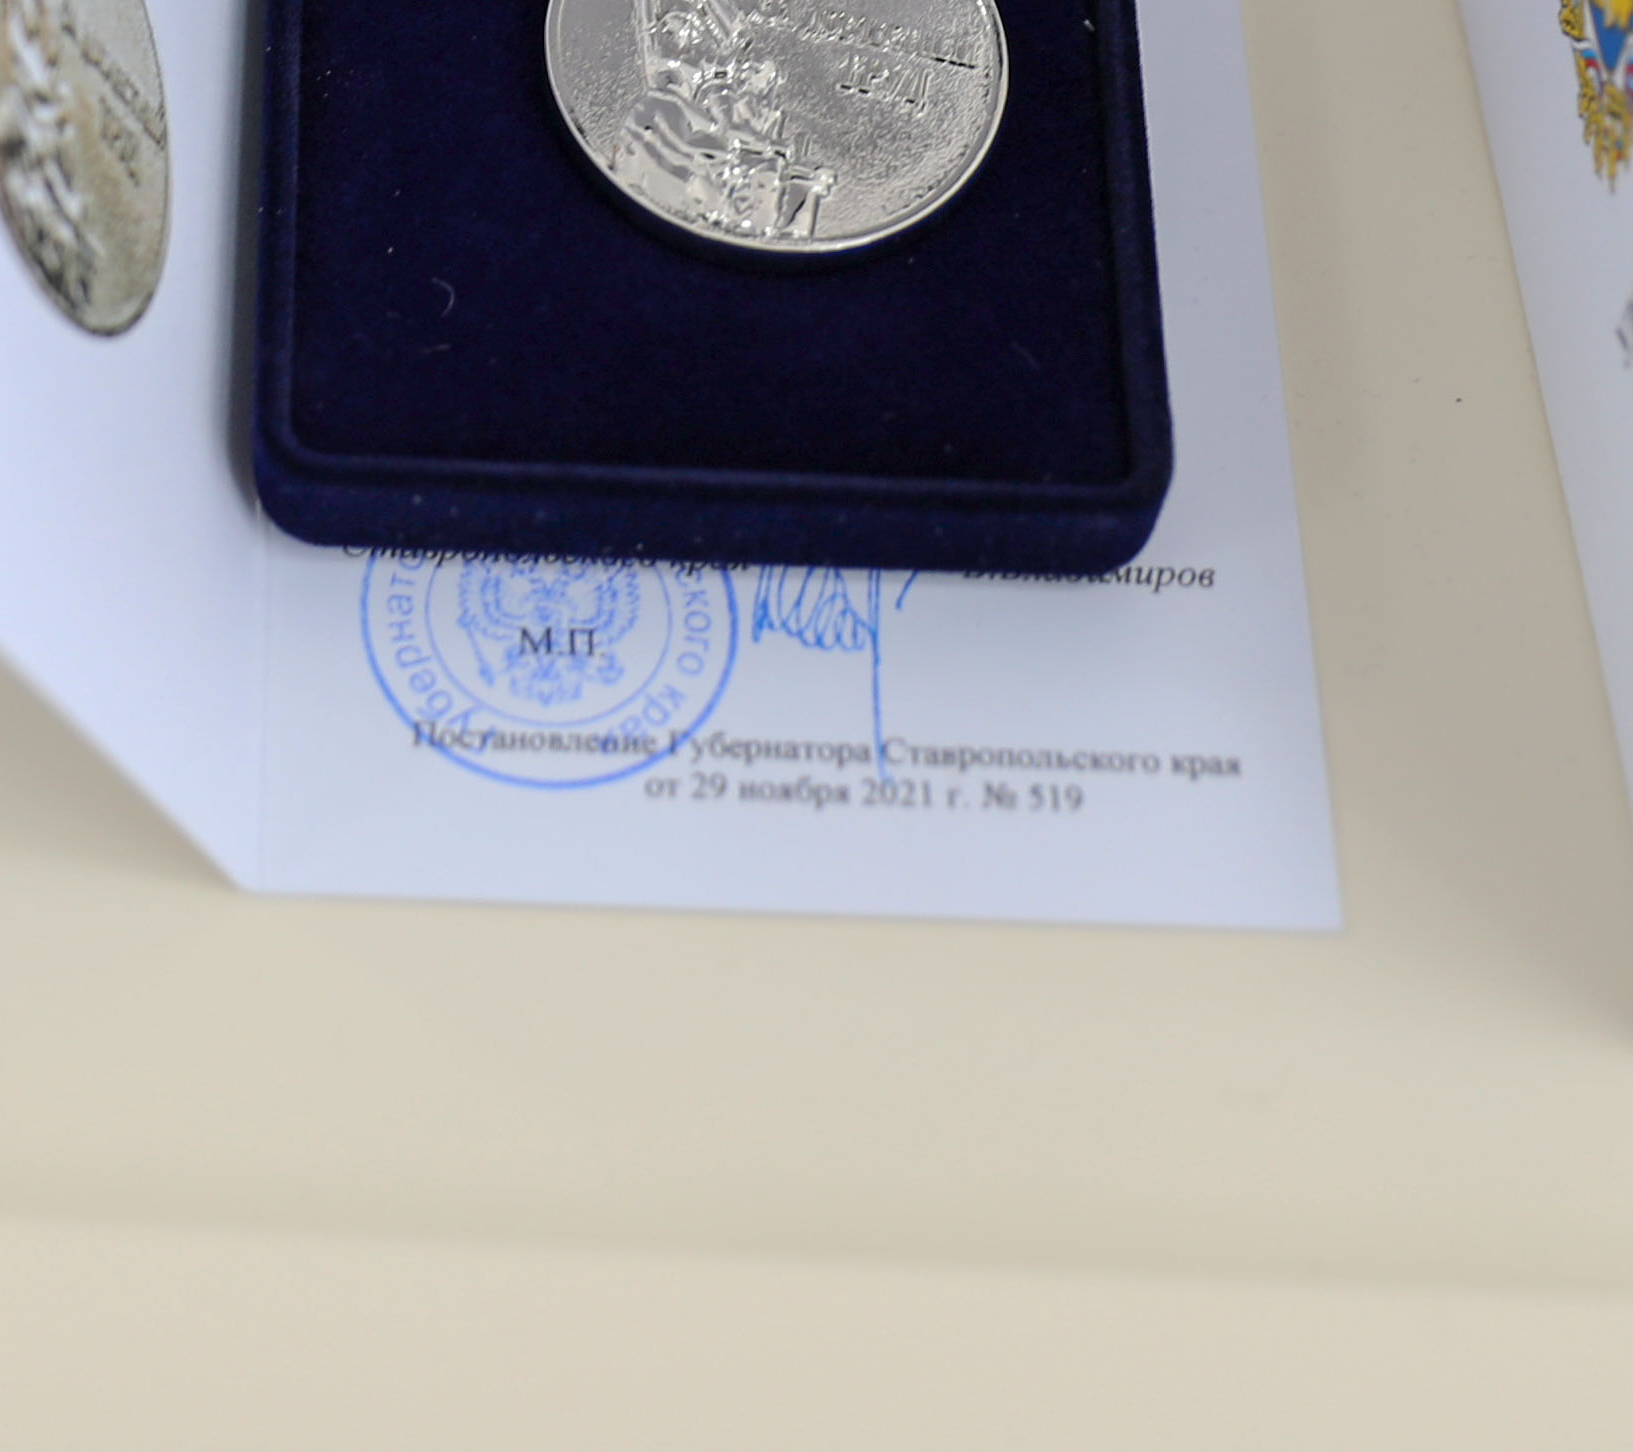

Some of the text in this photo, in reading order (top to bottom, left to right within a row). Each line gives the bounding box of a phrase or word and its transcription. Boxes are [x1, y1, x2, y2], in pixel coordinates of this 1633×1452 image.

[412, 720, 1241, 781] Постановление Губернатора Ставропольского края
[643, 777, 678, 799] от
[690, 771, 728, 800] 29
[738, 779, 850, 811] ноября
[861, 780, 933, 809] 2021
[1029, 782, 1085, 813] 519
